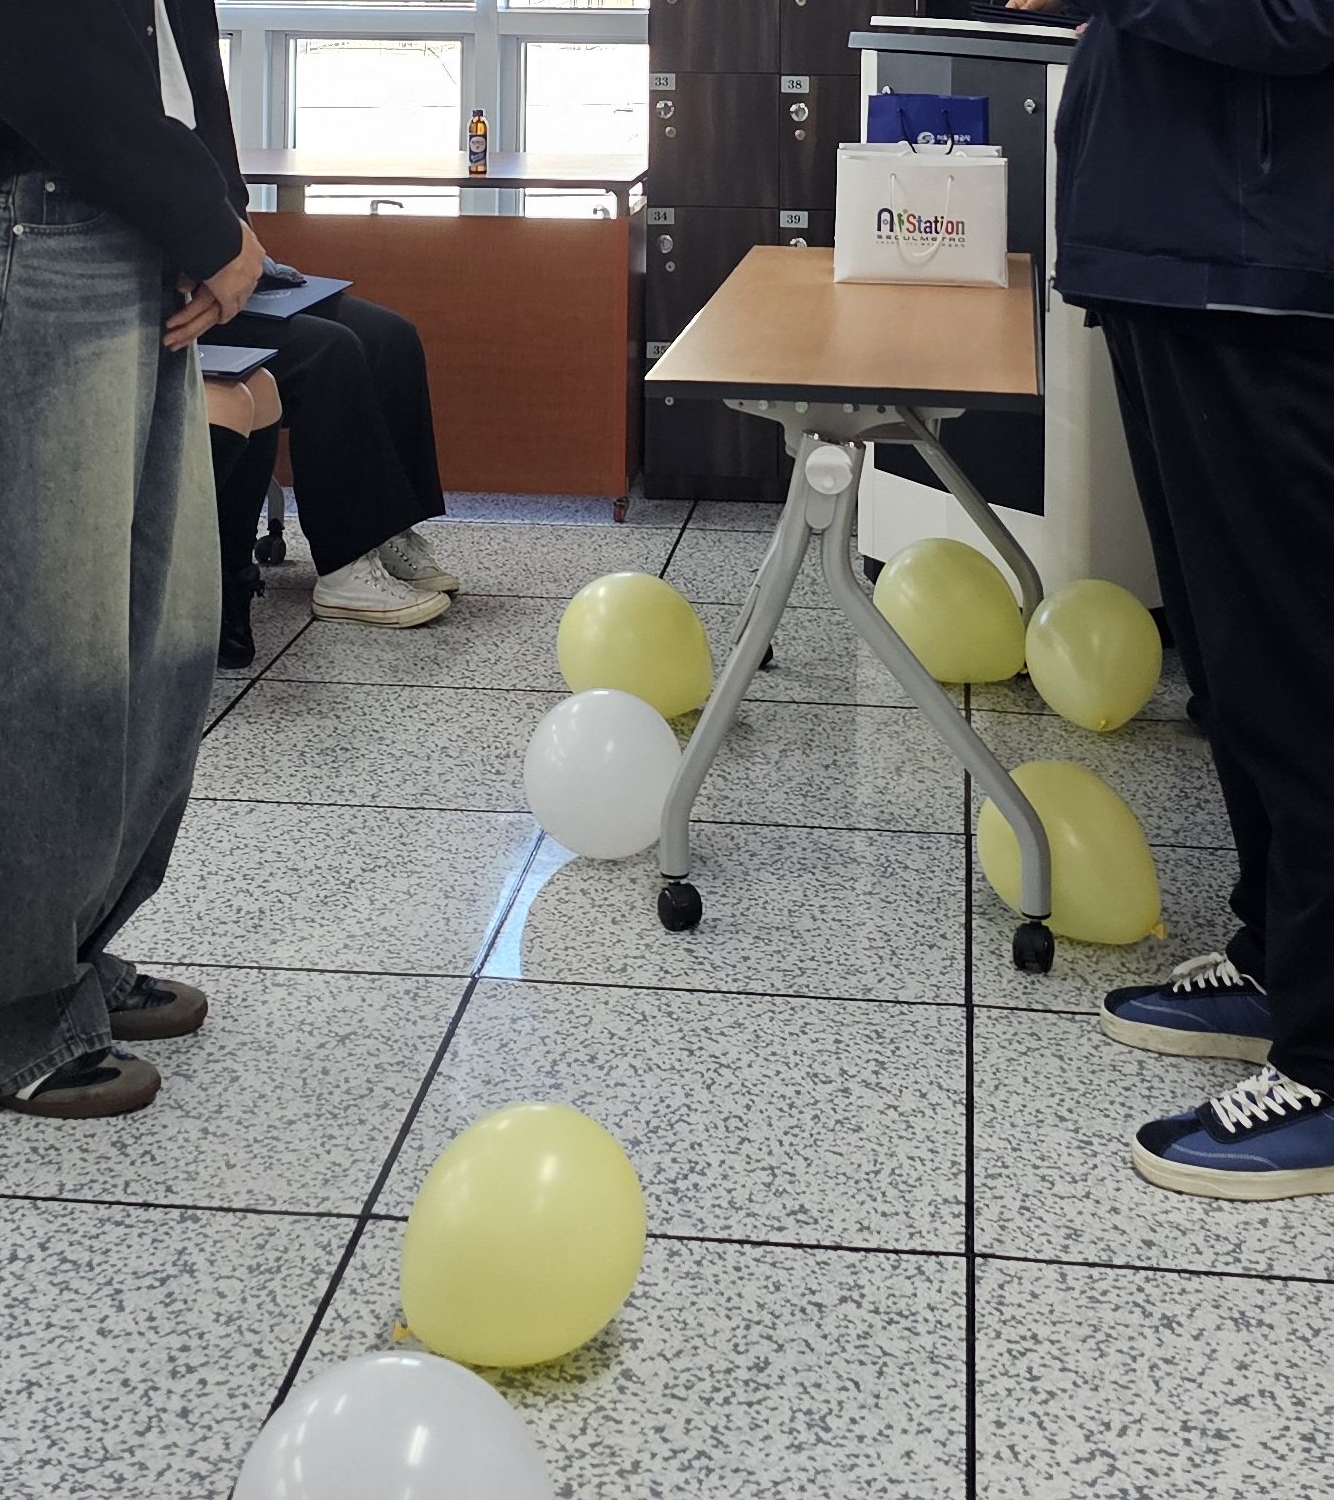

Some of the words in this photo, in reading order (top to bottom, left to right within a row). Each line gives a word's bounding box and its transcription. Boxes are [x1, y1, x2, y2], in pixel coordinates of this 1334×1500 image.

[654, 77, 669, 87] 33
[787, 80, 803, 90] 38
[653, 211, 668, 221] 34
[786, 215, 801, 225] 39
